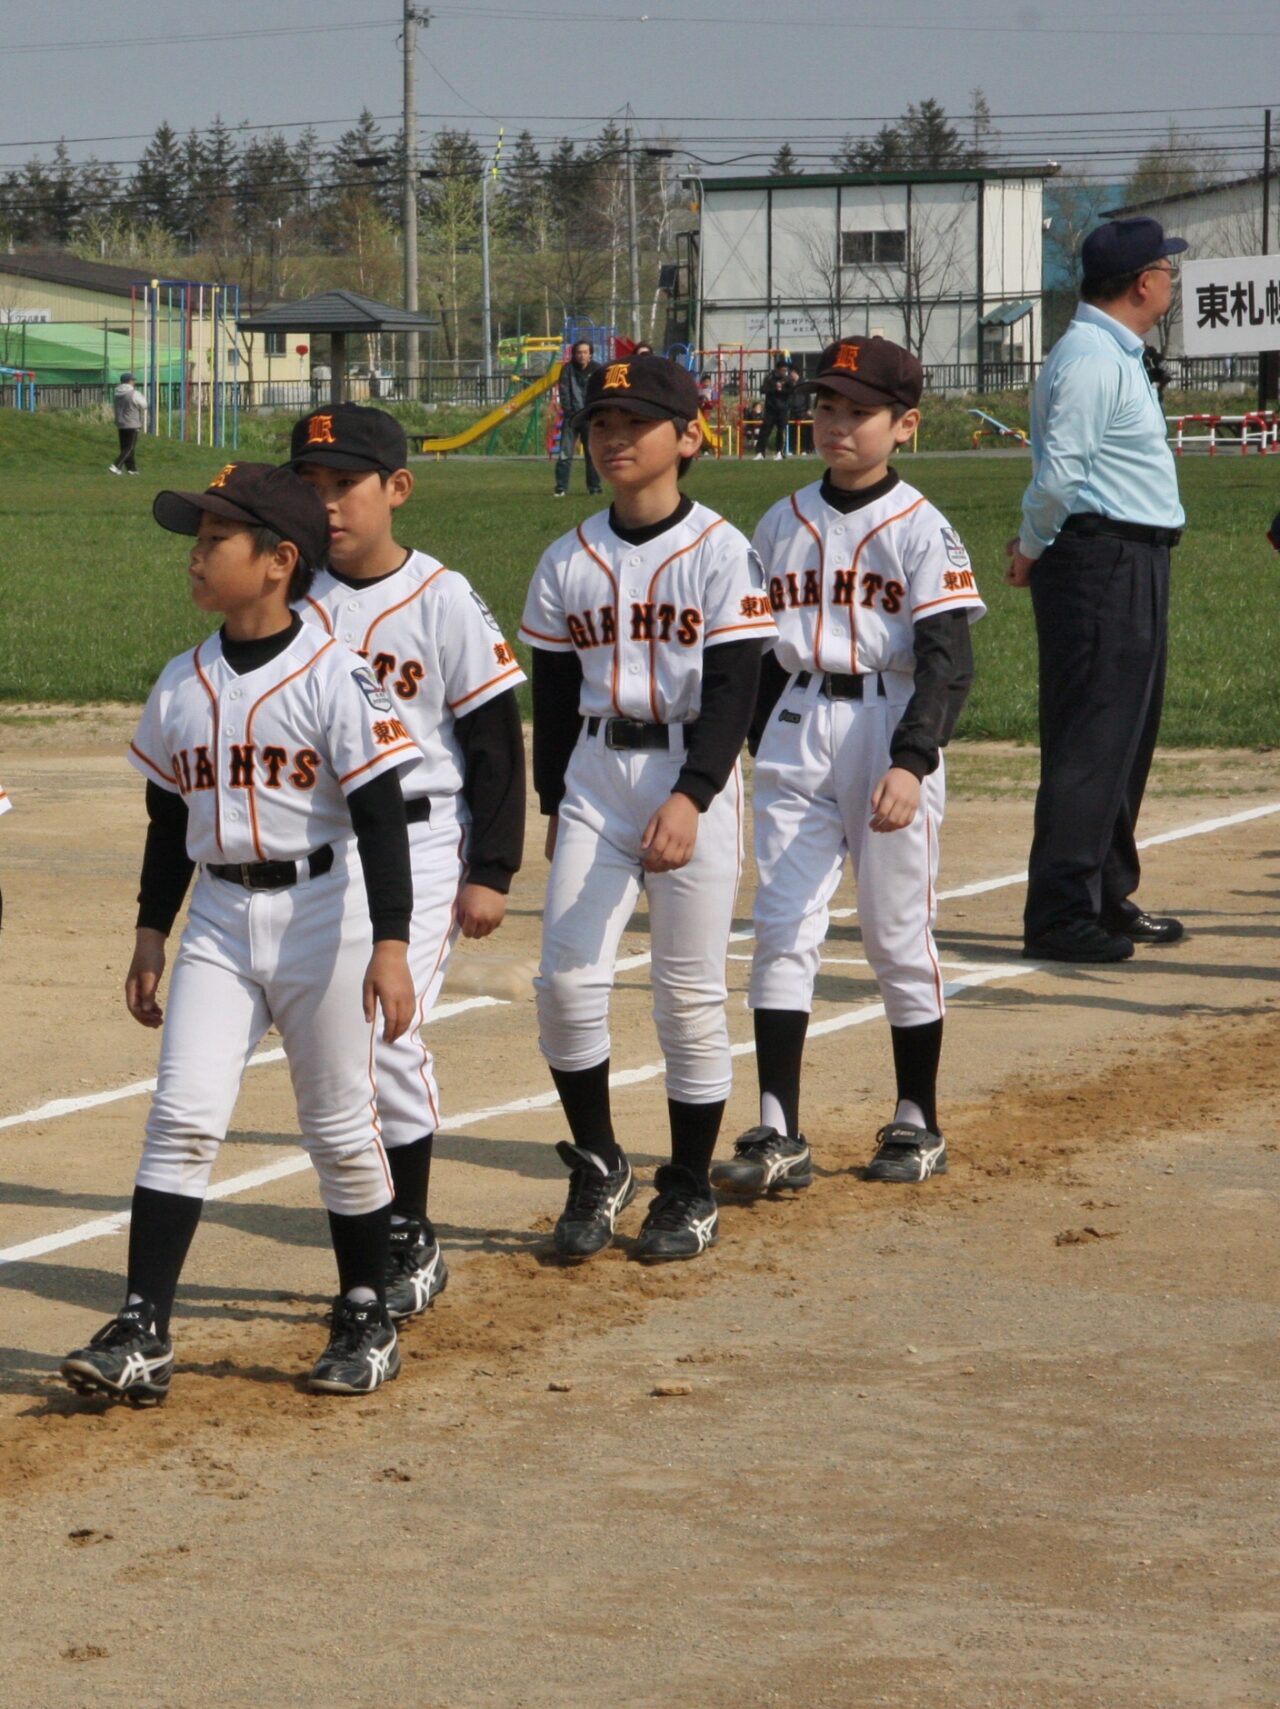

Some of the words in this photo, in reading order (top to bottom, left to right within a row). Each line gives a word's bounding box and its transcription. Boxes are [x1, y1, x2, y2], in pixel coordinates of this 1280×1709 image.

[770, 569, 906, 615] GIANTS
[943, 569, 977, 592] 東川
[567, 602, 704, 650] GIANTS
